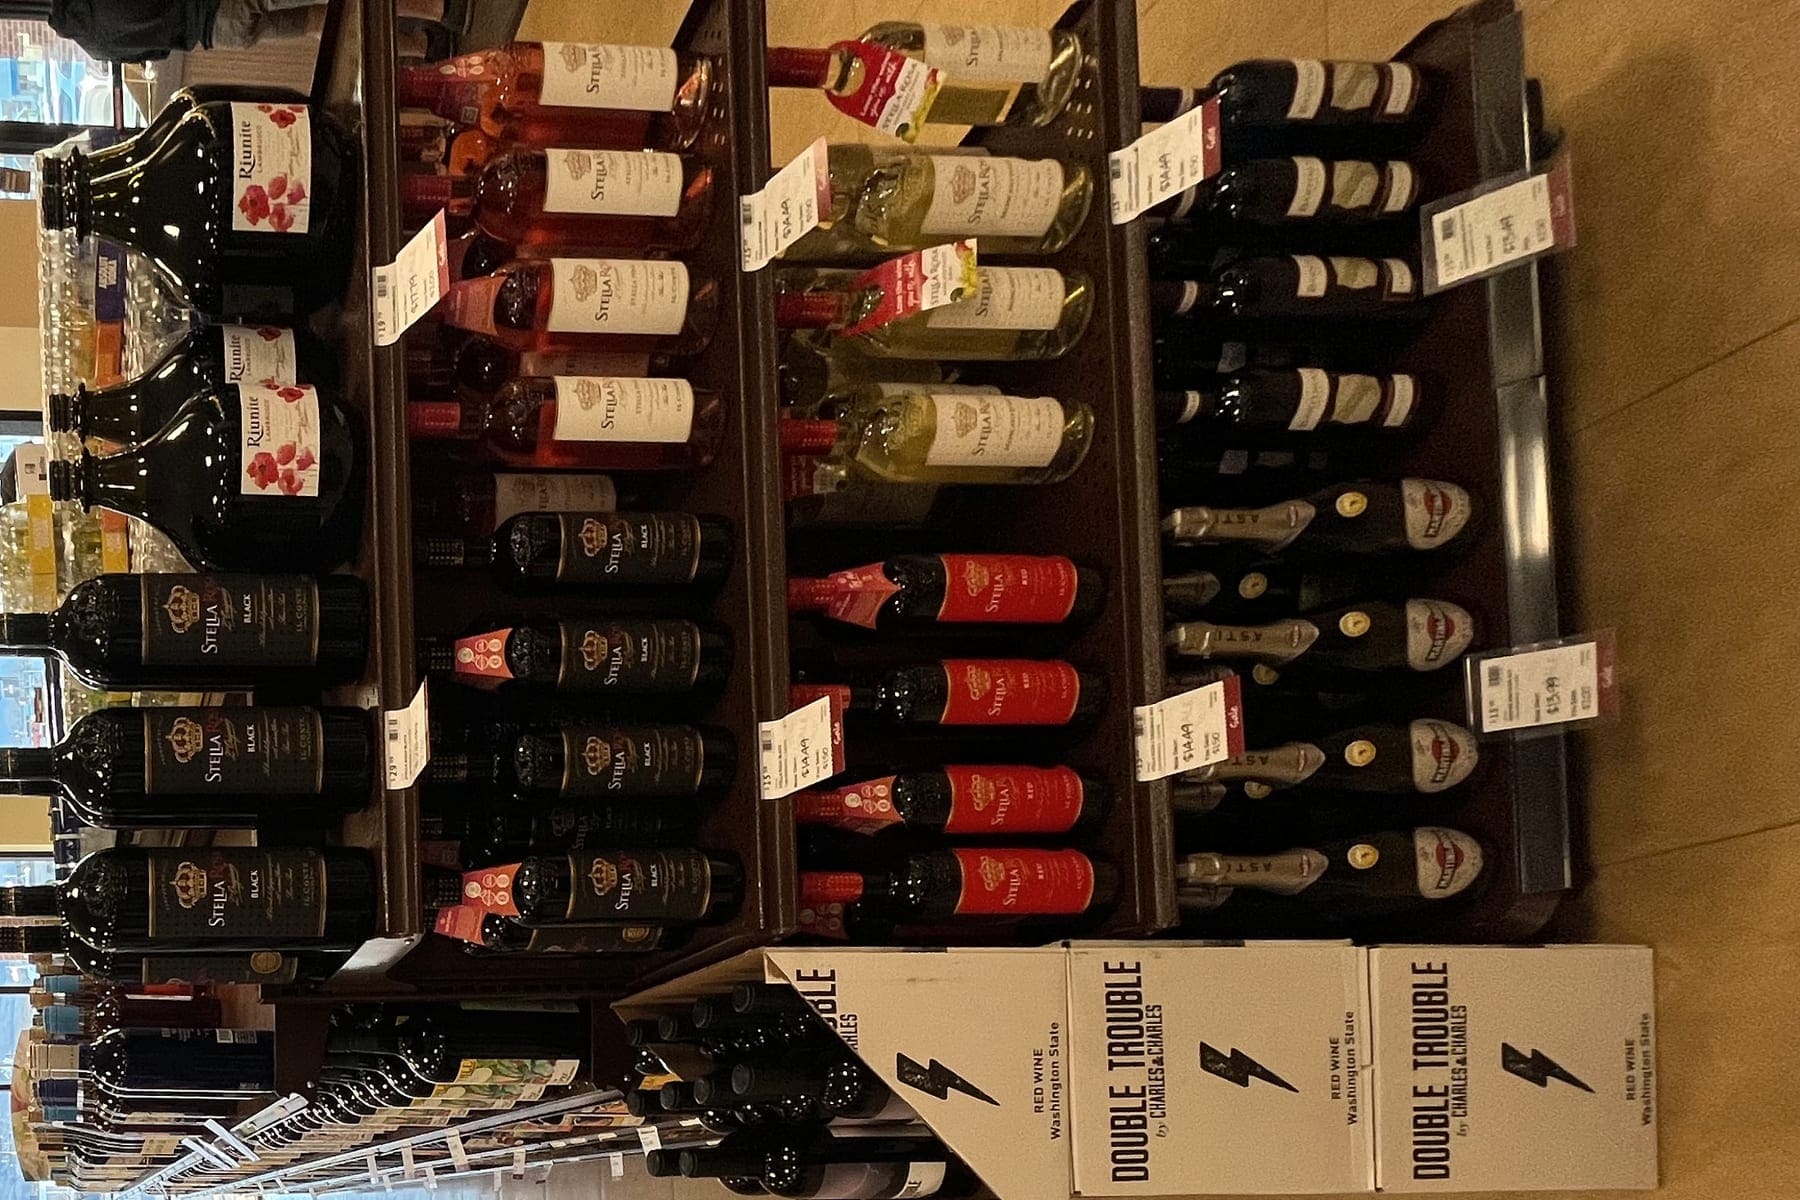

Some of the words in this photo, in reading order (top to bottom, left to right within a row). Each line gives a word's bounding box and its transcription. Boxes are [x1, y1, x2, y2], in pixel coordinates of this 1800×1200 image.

[586, 53, 602, 94] STELLA
[881, 95, 901, 129] STELLA
[899, 63, 917, 92] ROSA
[239, 120, 255, 179] Riunite
[591, 160, 606, 200] STELLA
[968, 181, 990, 224] STELLA
[930, 248, 940, 272] ROSA
[595, 275, 613, 321] STELLA
[930, 275, 941, 305] STELLA
[975, 277, 993, 316] STELLA
[229, 335, 245, 381] Riunite
[247, 397, 263, 447] Riunite
[602, 390, 617, 430] STELLA
[973, 416, 992, 456] STELLA
[1213, 513, 1259, 524] ASTI
[604, 533, 623, 574] STELLA
[242, 593, 252, 623] BLACK
[985, 574, 1004, 612] STELLA
[200, 605, 220, 654] STELLA
[1216, 630, 1262, 642] ASTI
[604, 646, 623, 685] STELLA
[641, 637, 649, 662] BLACK
[987, 678, 1006, 716] STELLA
[833, 721, 841, 745] Sale
[1228, 706, 1239, 728] Sale
[245, 724, 255, 752] BLACK
[204, 735, 224, 783] STELLA
[608, 752, 626, 790] STELLA
[1232, 755, 1269, 766] AST
[1434, 742, 1450, 780] MARTINI
[991, 789, 1010, 825] STELLA
[250, 870, 260, 898] BLACK
[650, 864, 658, 887] BLACK
[1226, 862, 1271, 873] ASTI
[208, 881, 228, 927] STELLA
[614, 873, 633, 910] STELLA
[1003, 869, 1020, 905] STELLA
[1104, 961, 1145, 1071] TROUBLE
[1344, 1011, 1354, 1045] State
[1412, 962, 1449, 1070] TROUBLE
[1640, 1013, 1650, 1046] State
[1050, 1022, 1060, 1056] State
[1329, 1037, 1339, 1071] WINE
[1625, 1039, 1634, 1071] WINE
[1033, 1048, 1043, 1083] WINE
[1033, 1087, 1044, 1113] RED
[1050, 1060, 1063, 1140] Washington
[1331, 1075, 1340, 1100] RED
[1347, 1049, 1358, 1125] Washington
[1626, 1075, 1635, 1100] RED
[1641, 1050, 1653, 1125] Washington
[1109, 1085, 1149, 1182] DOUBLE
[1155, 1121, 1168, 1138] by
[1413, 1085, 1450, 1179] DOUBLE
[1456, 1122, 1468, 1136] by
